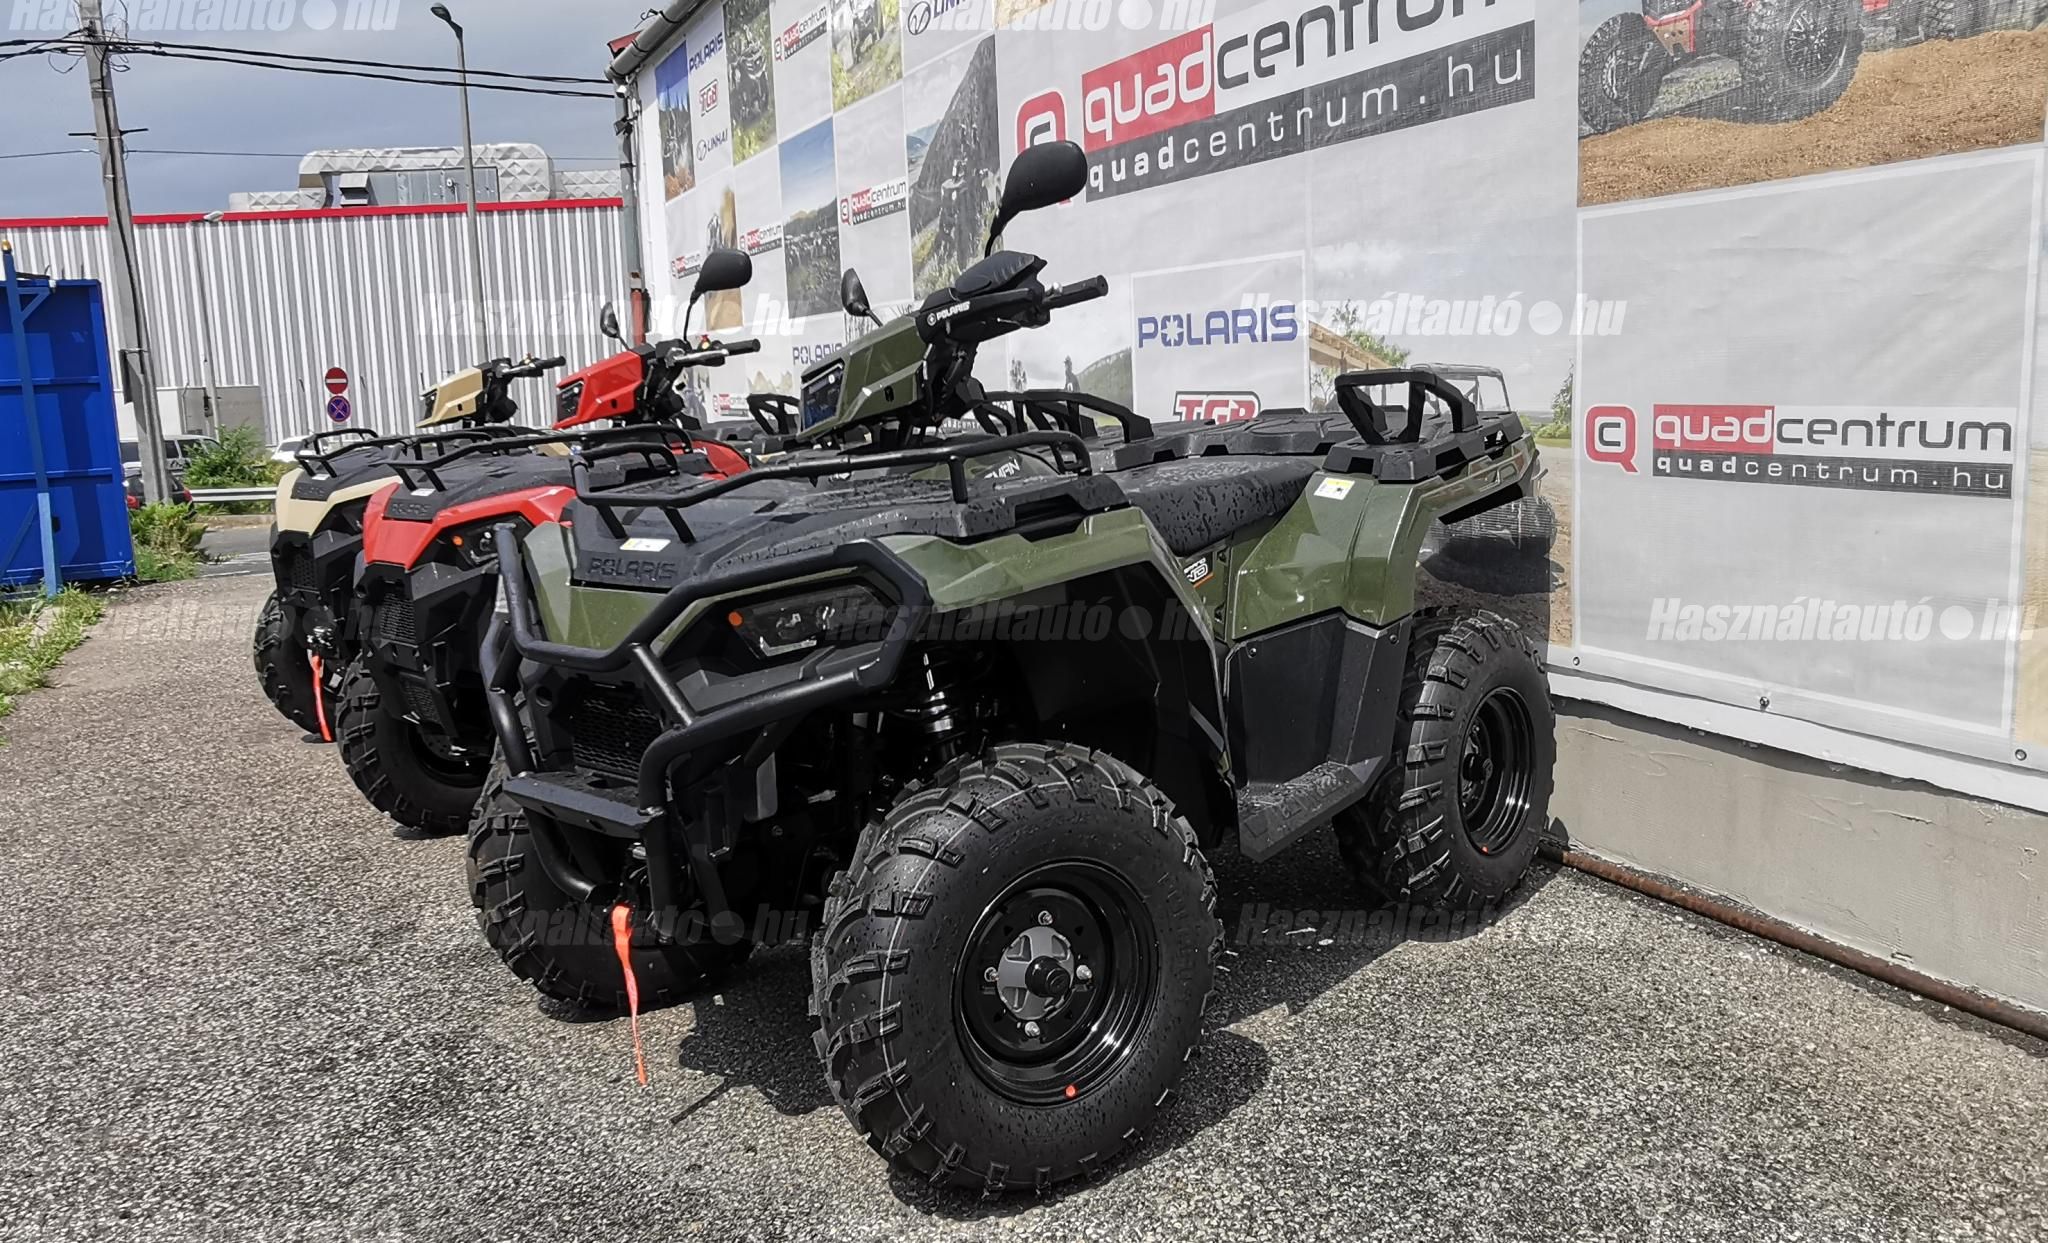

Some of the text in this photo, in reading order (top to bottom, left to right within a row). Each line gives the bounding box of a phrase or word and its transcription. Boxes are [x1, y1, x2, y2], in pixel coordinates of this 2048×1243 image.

[689, 32, 723, 72] POLARIS
[1085, 0, 1496, 141] quadcentru
[1090, 48, 1522, 191] quadcentrum.hu
[936, 300, 970, 321] POLARIS
[1137, 304, 1298, 349] POLARIS
[1655, 409, 2012, 452] quadcentrum
[1657, 456, 2004, 490] quadcentrum.hu
[587, 557, 678, 581] POLARIS
